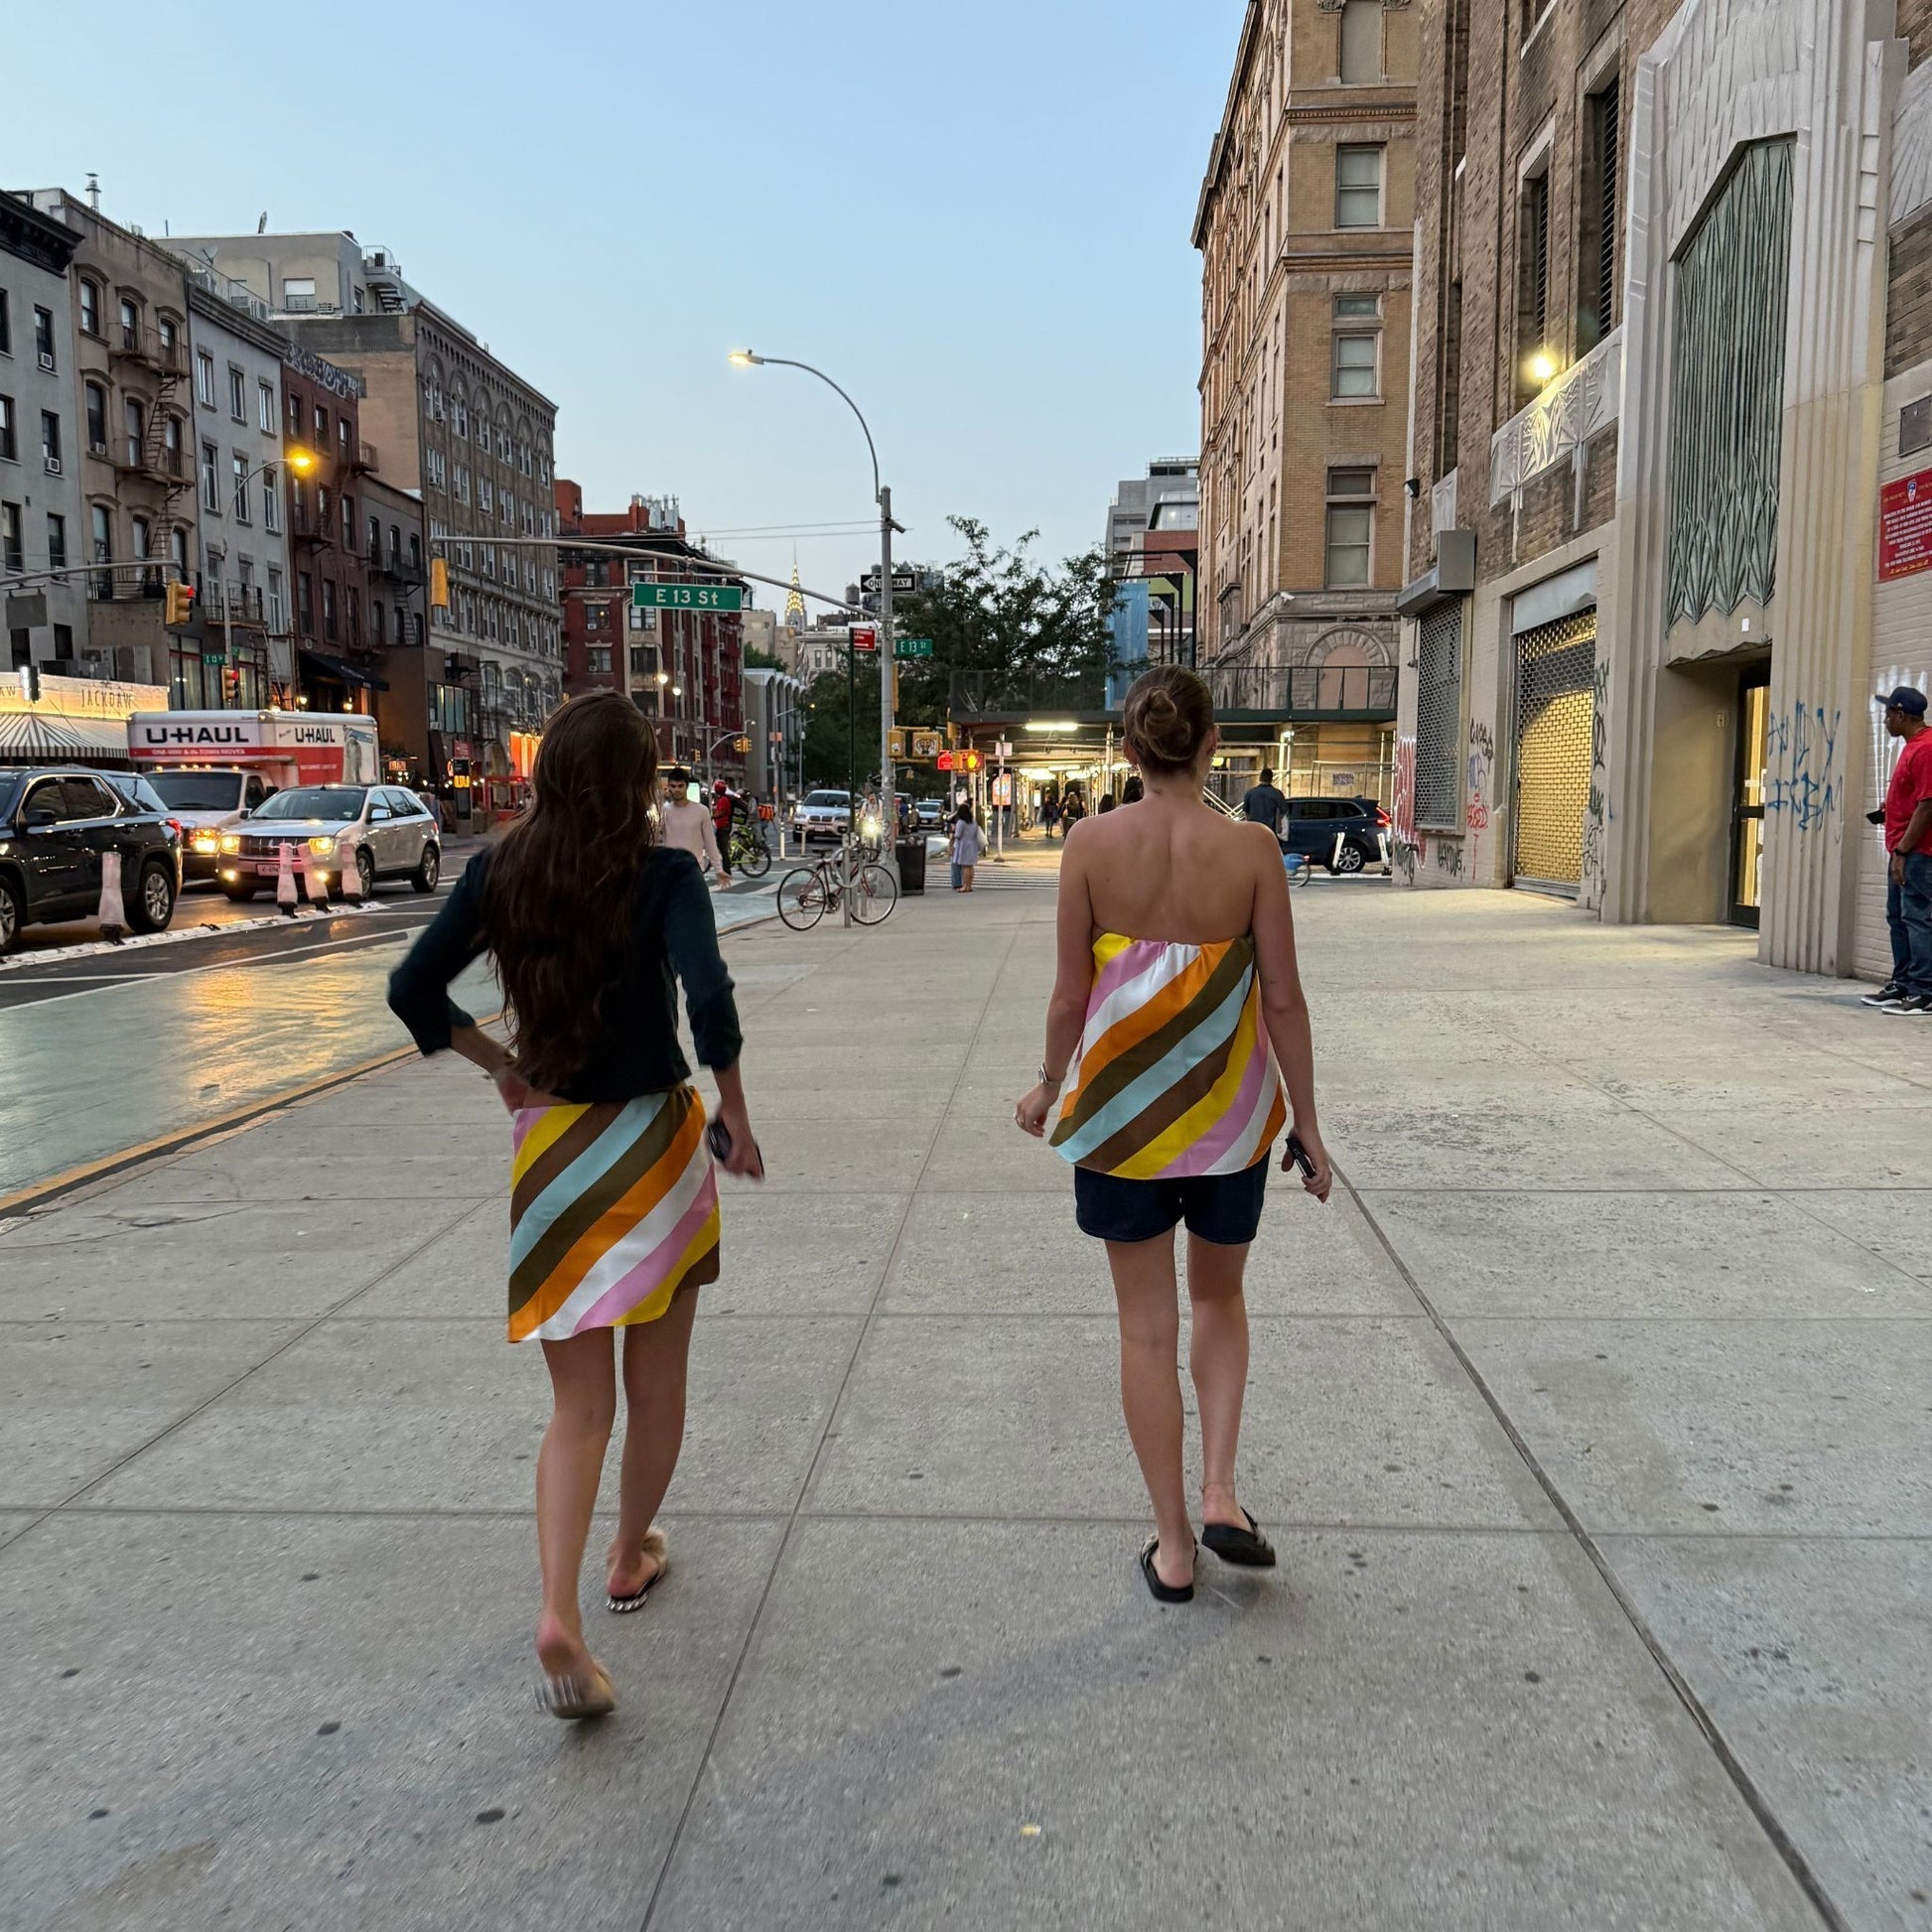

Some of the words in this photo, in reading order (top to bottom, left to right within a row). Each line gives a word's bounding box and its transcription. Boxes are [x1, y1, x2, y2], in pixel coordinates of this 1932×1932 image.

[656, 589, 666, 603] E
[673, 590, 691, 604] 13
[698, 591, 719, 606] St
[900, 641, 905, 652] E
[909, 641, 917, 652] 13
[80, 689, 132, 708] JACKDAW
[146, 727, 249, 744] U-HAUL
[295, 728, 336, 744] U-HAUL
